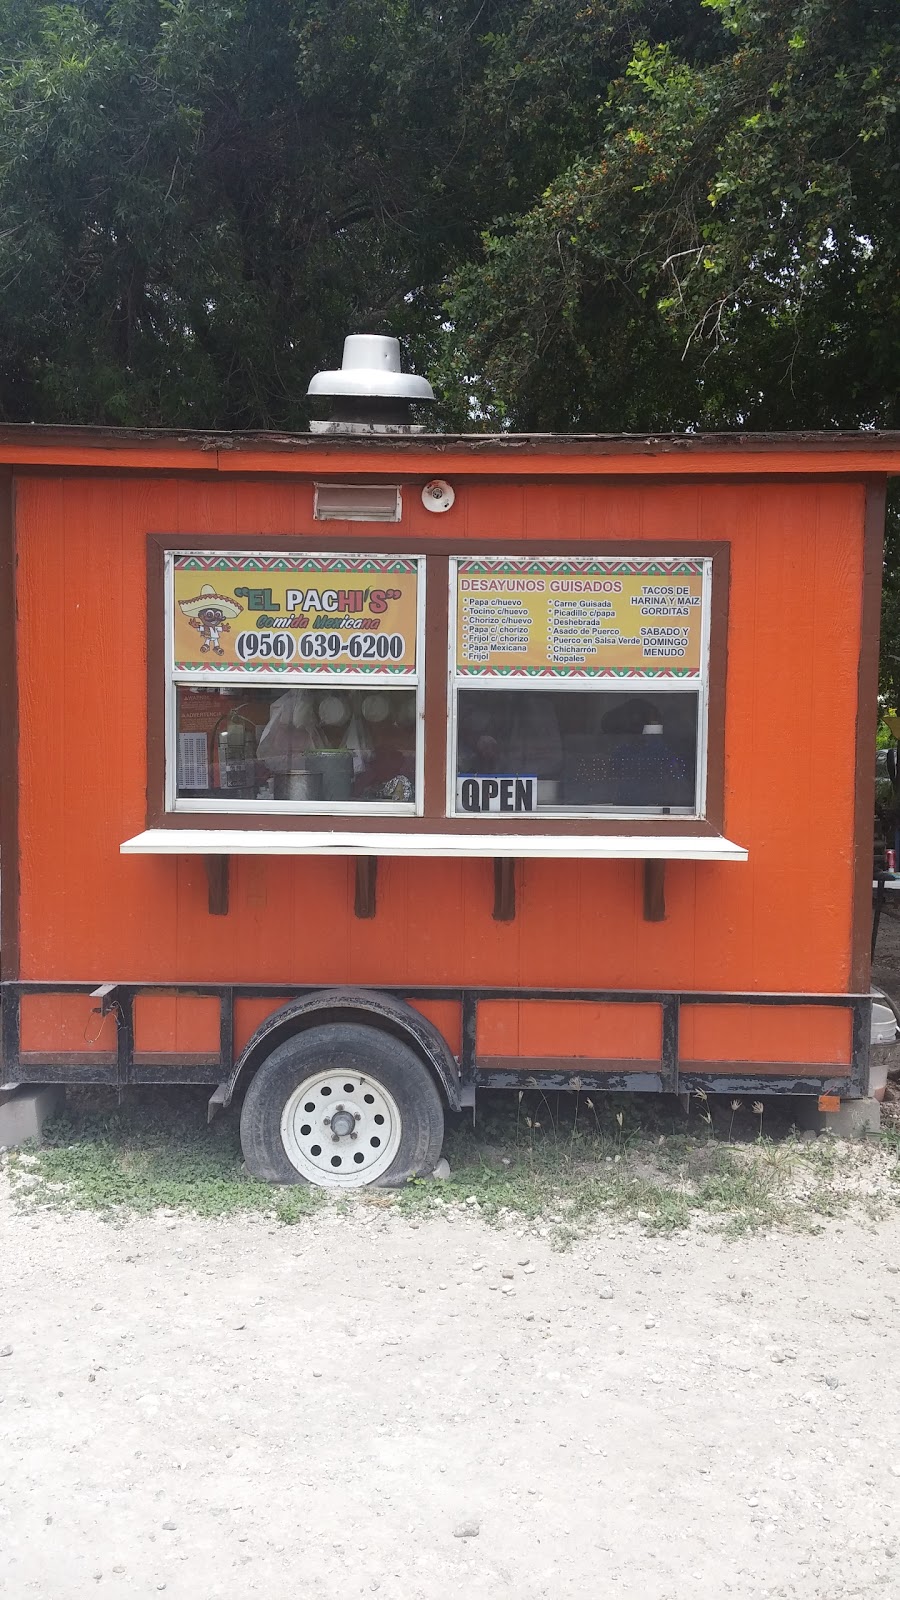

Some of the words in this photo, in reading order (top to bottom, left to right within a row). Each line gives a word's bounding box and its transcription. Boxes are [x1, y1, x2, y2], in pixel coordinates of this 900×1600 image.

[461, 579, 545, 591] DESAYUNOS
[550, 581, 622, 592] GUISADOS
[642, 586, 674, 595] TACOS
[676, 587, 689, 595] DE
[469, 598, 489, 607] Papa
[490, 598, 522, 606] c/huevo
[554, 600, 577, 608] Carne
[579, 600, 612, 608] Guisada
[631, 597, 667, 605] HARINA
[669, 597, 676, 605] Y
[677, 597, 700, 605] MAIZ
[469, 607, 495, 615] Tocino
[554, 609, 587, 617] Picadillo
[589, 610, 616, 618] c/papa
[641, 607, 689, 615] GORDITAS
[256, 614, 310, 629] Comida
[312, 614, 381, 630] Mexicana
[469, 616, 499, 624] Chorizo
[553, 618, 600, 626] Deshebrada
[469, 626, 488, 634] Papa
[640, 628, 681, 636] SABADO
[682, 628, 689, 636] Y
[468, 635, 489, 643] Frijol
[594, 637, 616, 645] Salsa
[617, 637, 640, 645] Verde
[643, 638, 688, 646] DOMINGO
[237, 632, 294, 659] (956)
[300, 633, 403, 659] 639-6200
[468, 644, 488, 652] Papa
[490, 644, 527, 652] Mexicana
[553, 645, 597, 653] Chicharrón
[643, 648, 685, 656] MENUDO
[468, 653, 489, 661] Frijol
[553, 655, 585, 663] Nopales
